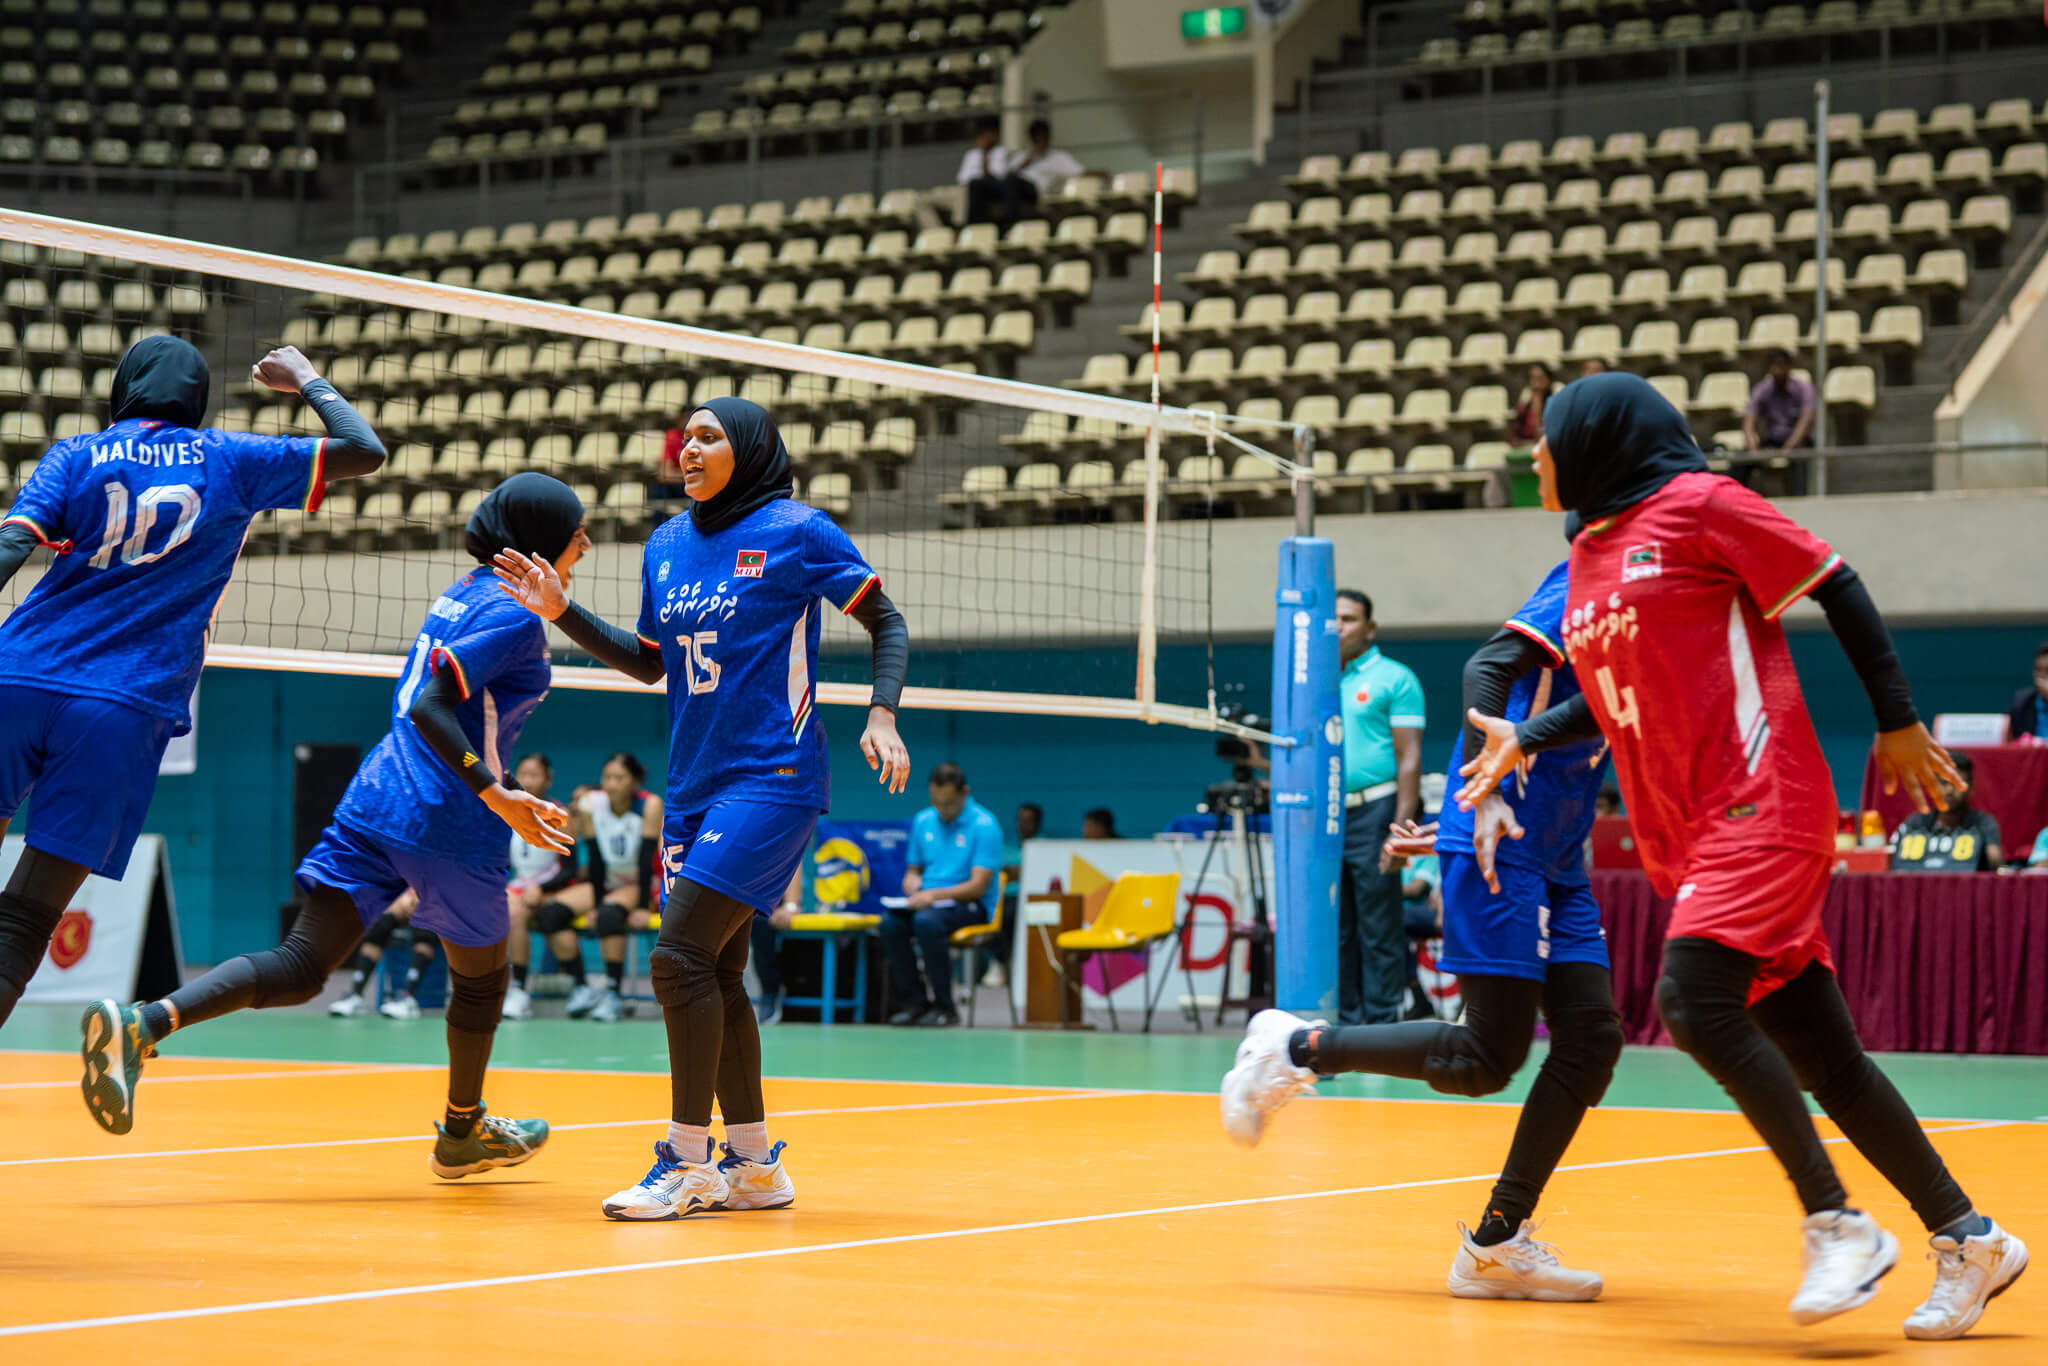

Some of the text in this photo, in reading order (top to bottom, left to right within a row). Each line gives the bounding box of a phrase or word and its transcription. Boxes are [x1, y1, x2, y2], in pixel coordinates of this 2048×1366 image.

[90, 438, 205, 468] MALDIVES
[88, 481, 202, 570] 10
[676, 631, 722, 696] 15
[1595, 665, 1643, 740] 4
